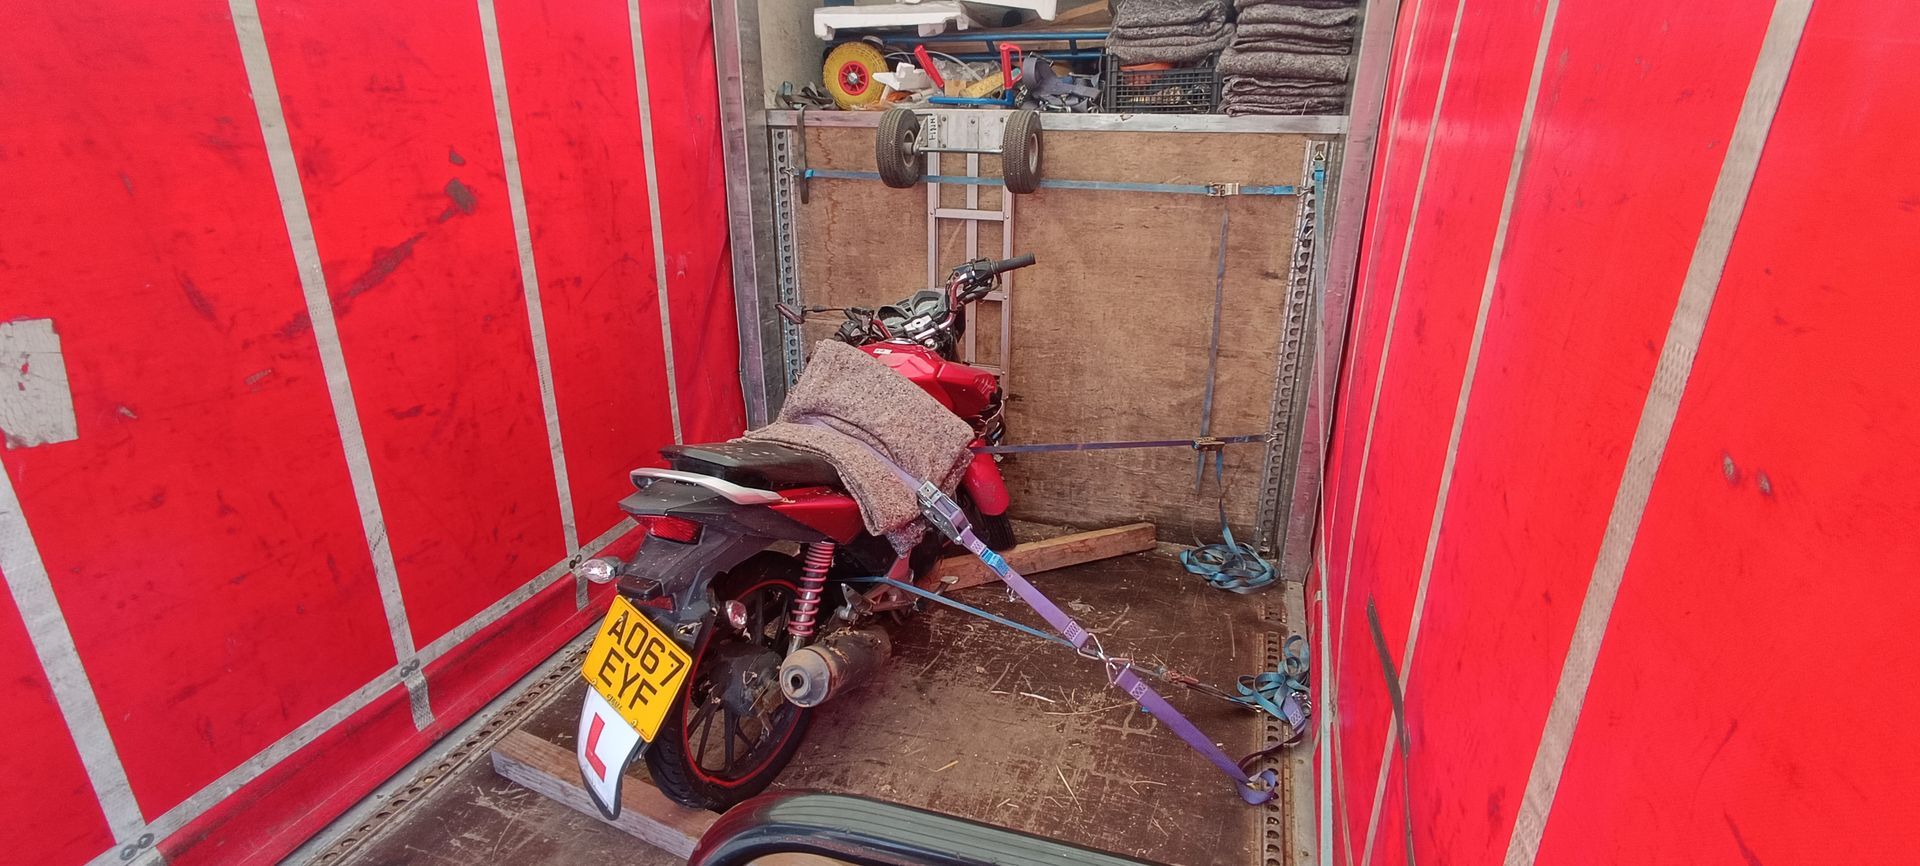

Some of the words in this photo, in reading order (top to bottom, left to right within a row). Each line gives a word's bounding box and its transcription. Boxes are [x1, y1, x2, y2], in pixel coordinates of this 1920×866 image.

[598, 646, 658, 710] EYF
[607, 609, 686, 687] AO67
[584, 712, 607, 783] L
